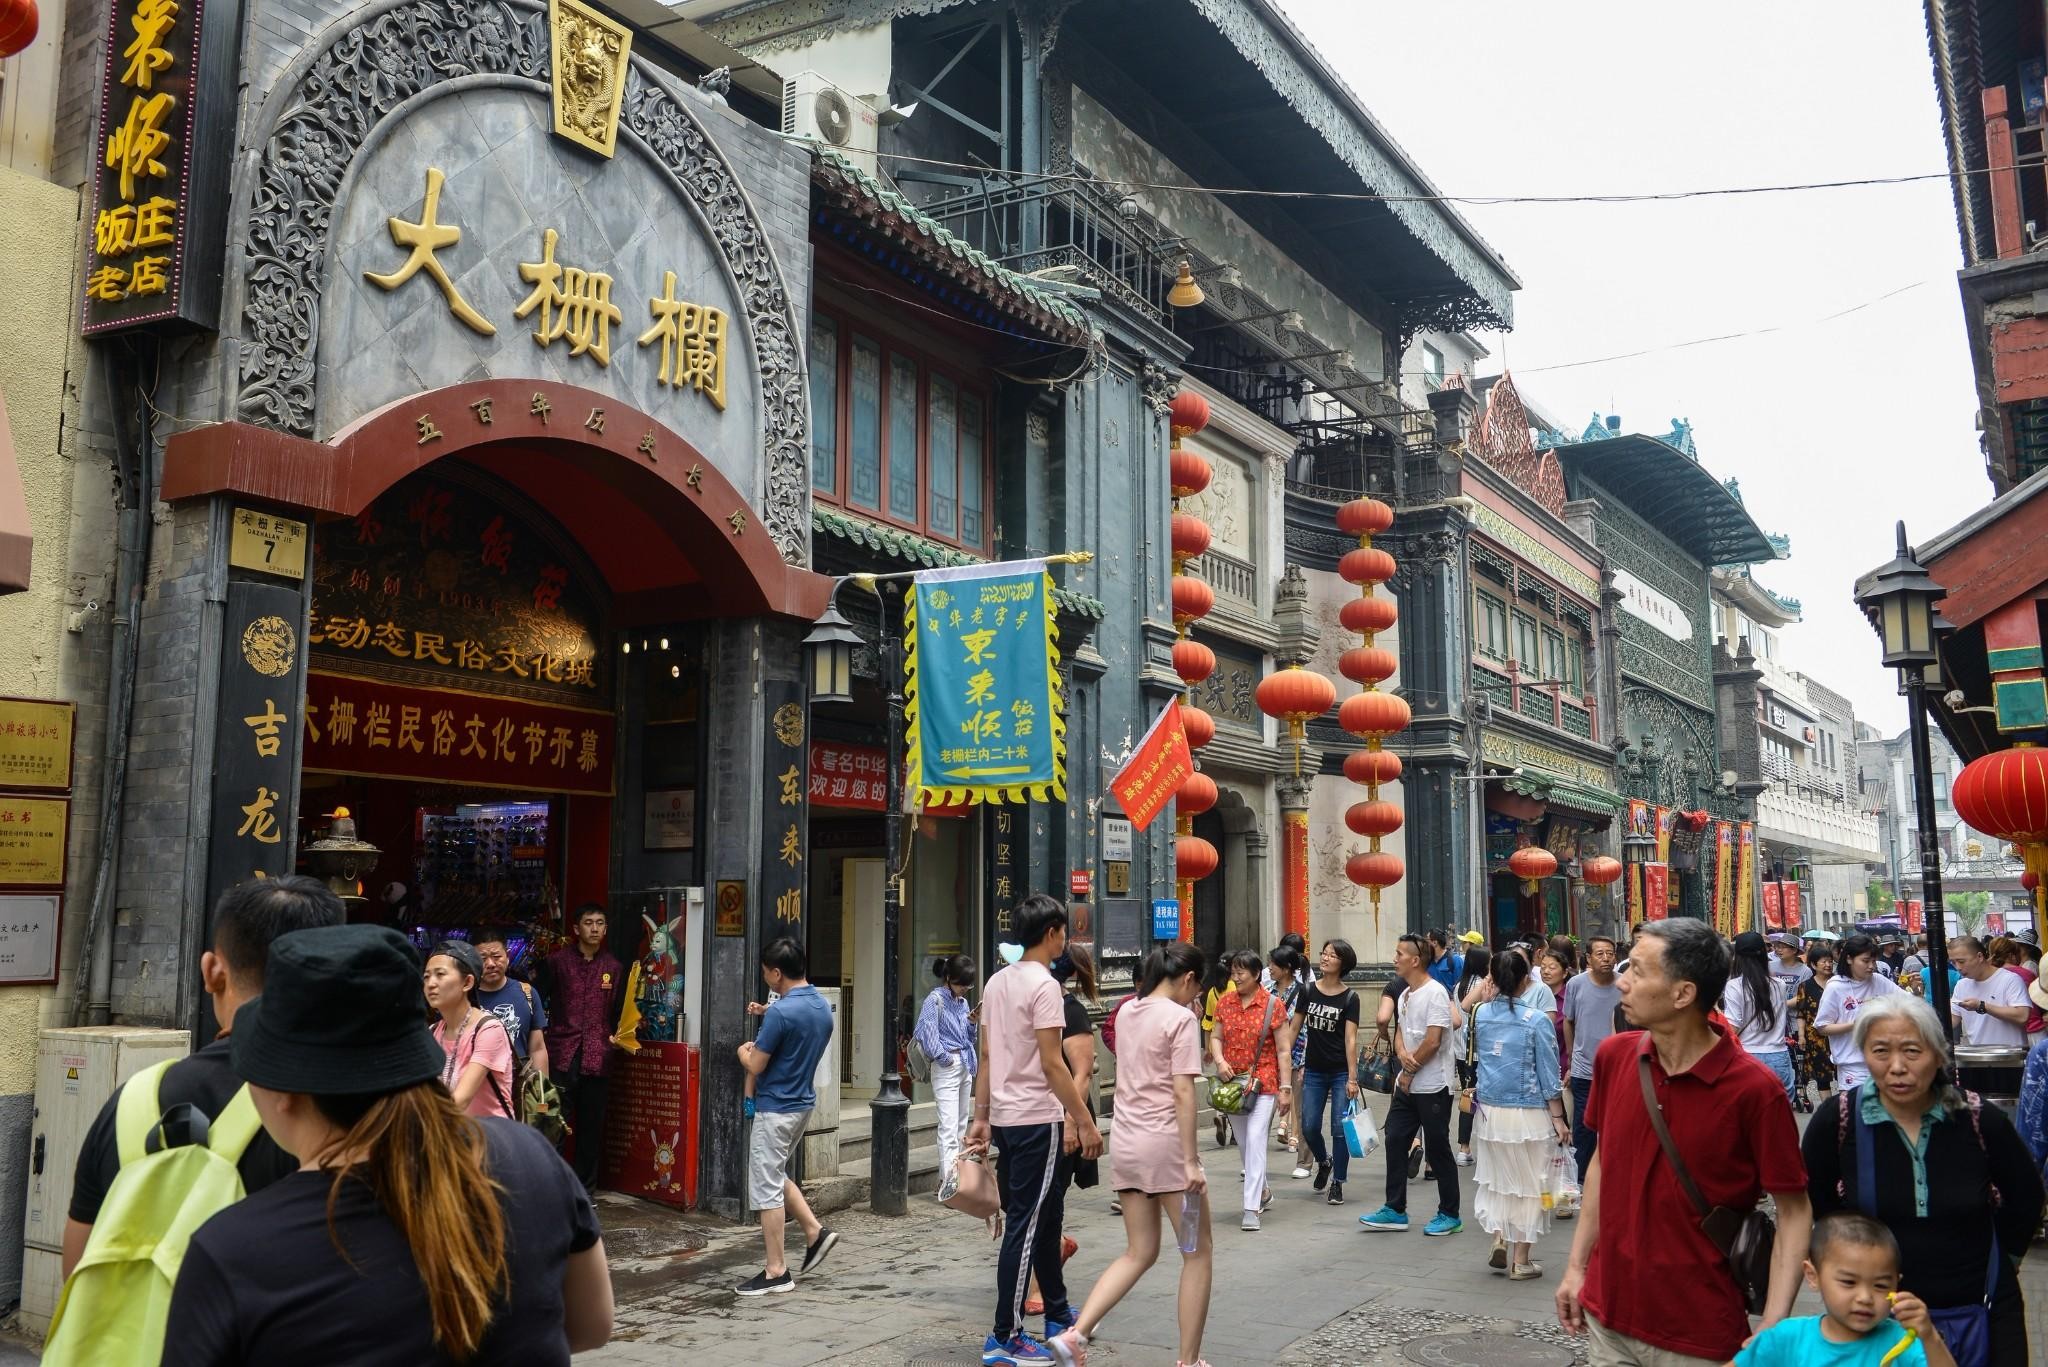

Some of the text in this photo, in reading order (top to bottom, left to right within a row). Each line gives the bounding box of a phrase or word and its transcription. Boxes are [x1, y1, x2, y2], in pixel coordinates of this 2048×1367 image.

[95, 196, 176, 257] 饭庄
[87, 255, 171, 302] 老店
[240, 513, 301, 538] 大栅栏街
[247, 528, 293, 544] DAZHALAN JIE
[264, 539, 275, 564] 7
[927, 606, 1029, 637] 中华老字号
[811, 747, 907, 776] （著名中华
[237, 698, 288, 886] 吉龙
[809, 774, 907, 805] 欢迎您的
[777, 764, 803, 924] 东来顺
[1117, 875, 1122, 888] 5
[1156, 920, 1178, 929] TAX FREE
[1306, 1014, 1337, 1032] LIFE
[1307, 1001, 1344, 1020] HAPPY
